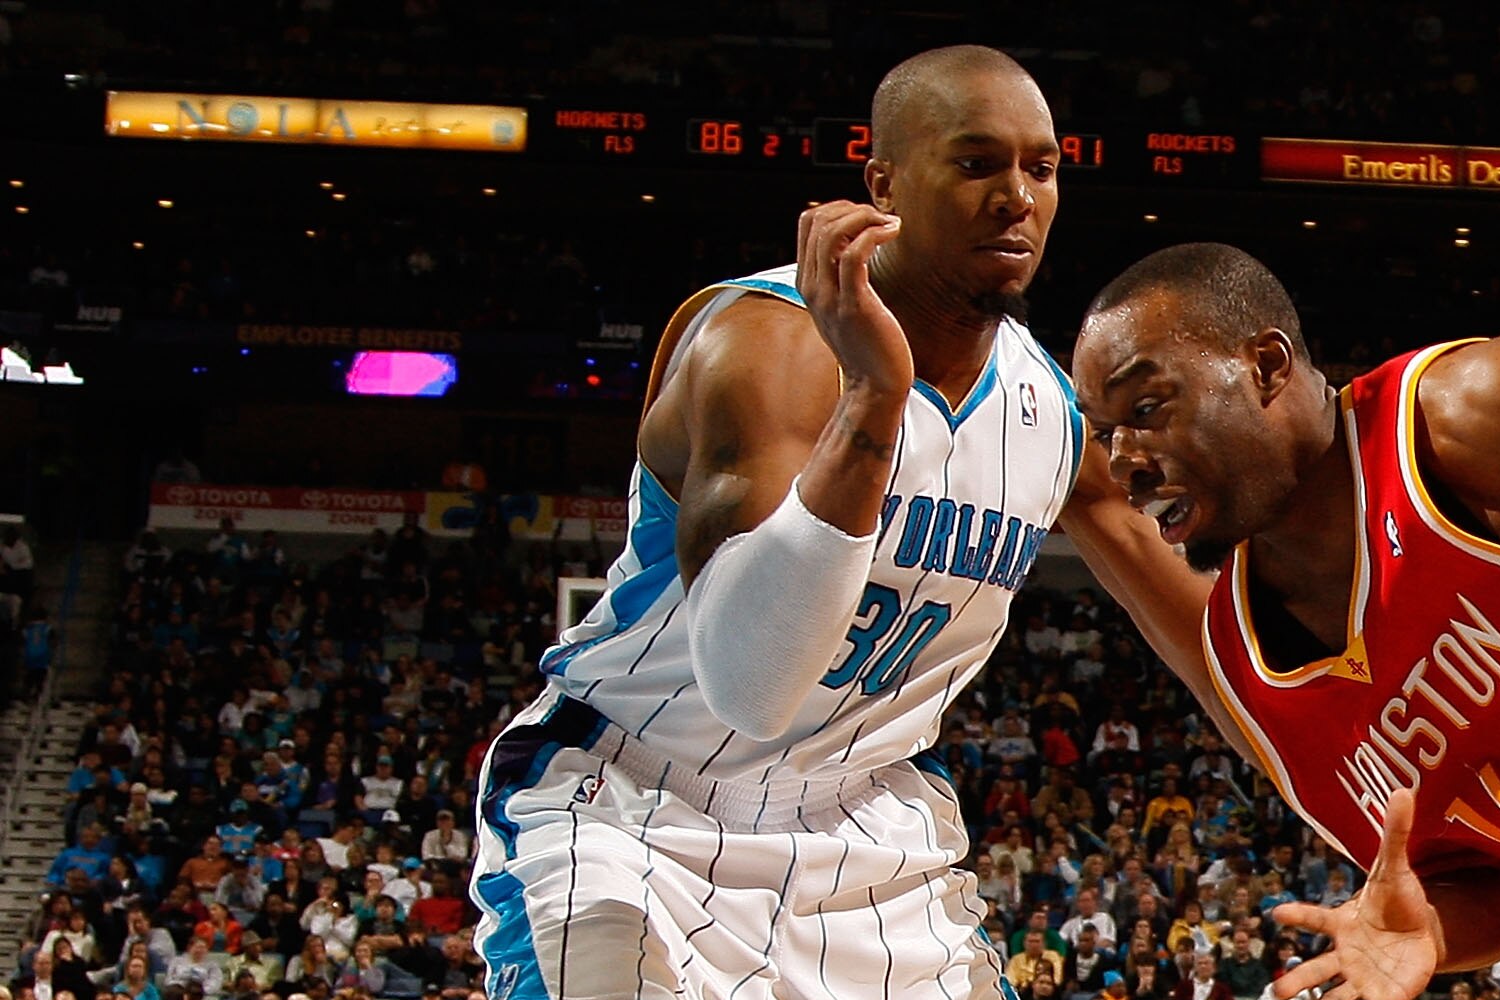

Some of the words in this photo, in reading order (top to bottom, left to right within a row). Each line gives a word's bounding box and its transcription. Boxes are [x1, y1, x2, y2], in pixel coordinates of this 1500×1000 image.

[554, 110, 647, 130] HORNETS
[603, 135, 635, 154] FLS
[700, 120, 742, 154] 86
[761, 134, 781, 157] 2
[1147, 133, 1236, 155] ROCKETS
[1061, 136, 1103, 165] 91
[1153, 155, 1184, 176] FLS
[1342, 154, 1452, 183] Emeril's
[236, 322, 352, 344] EMPLOYEE
[357, 328, 462, 350] BENEFITS
[196, 488, 271, 506] TOYOTA
[329, 493, 405, 510] TOYOTA
[893, 495, 1049, 594] ORLEAN
[818, 580, 952, 696] 30
